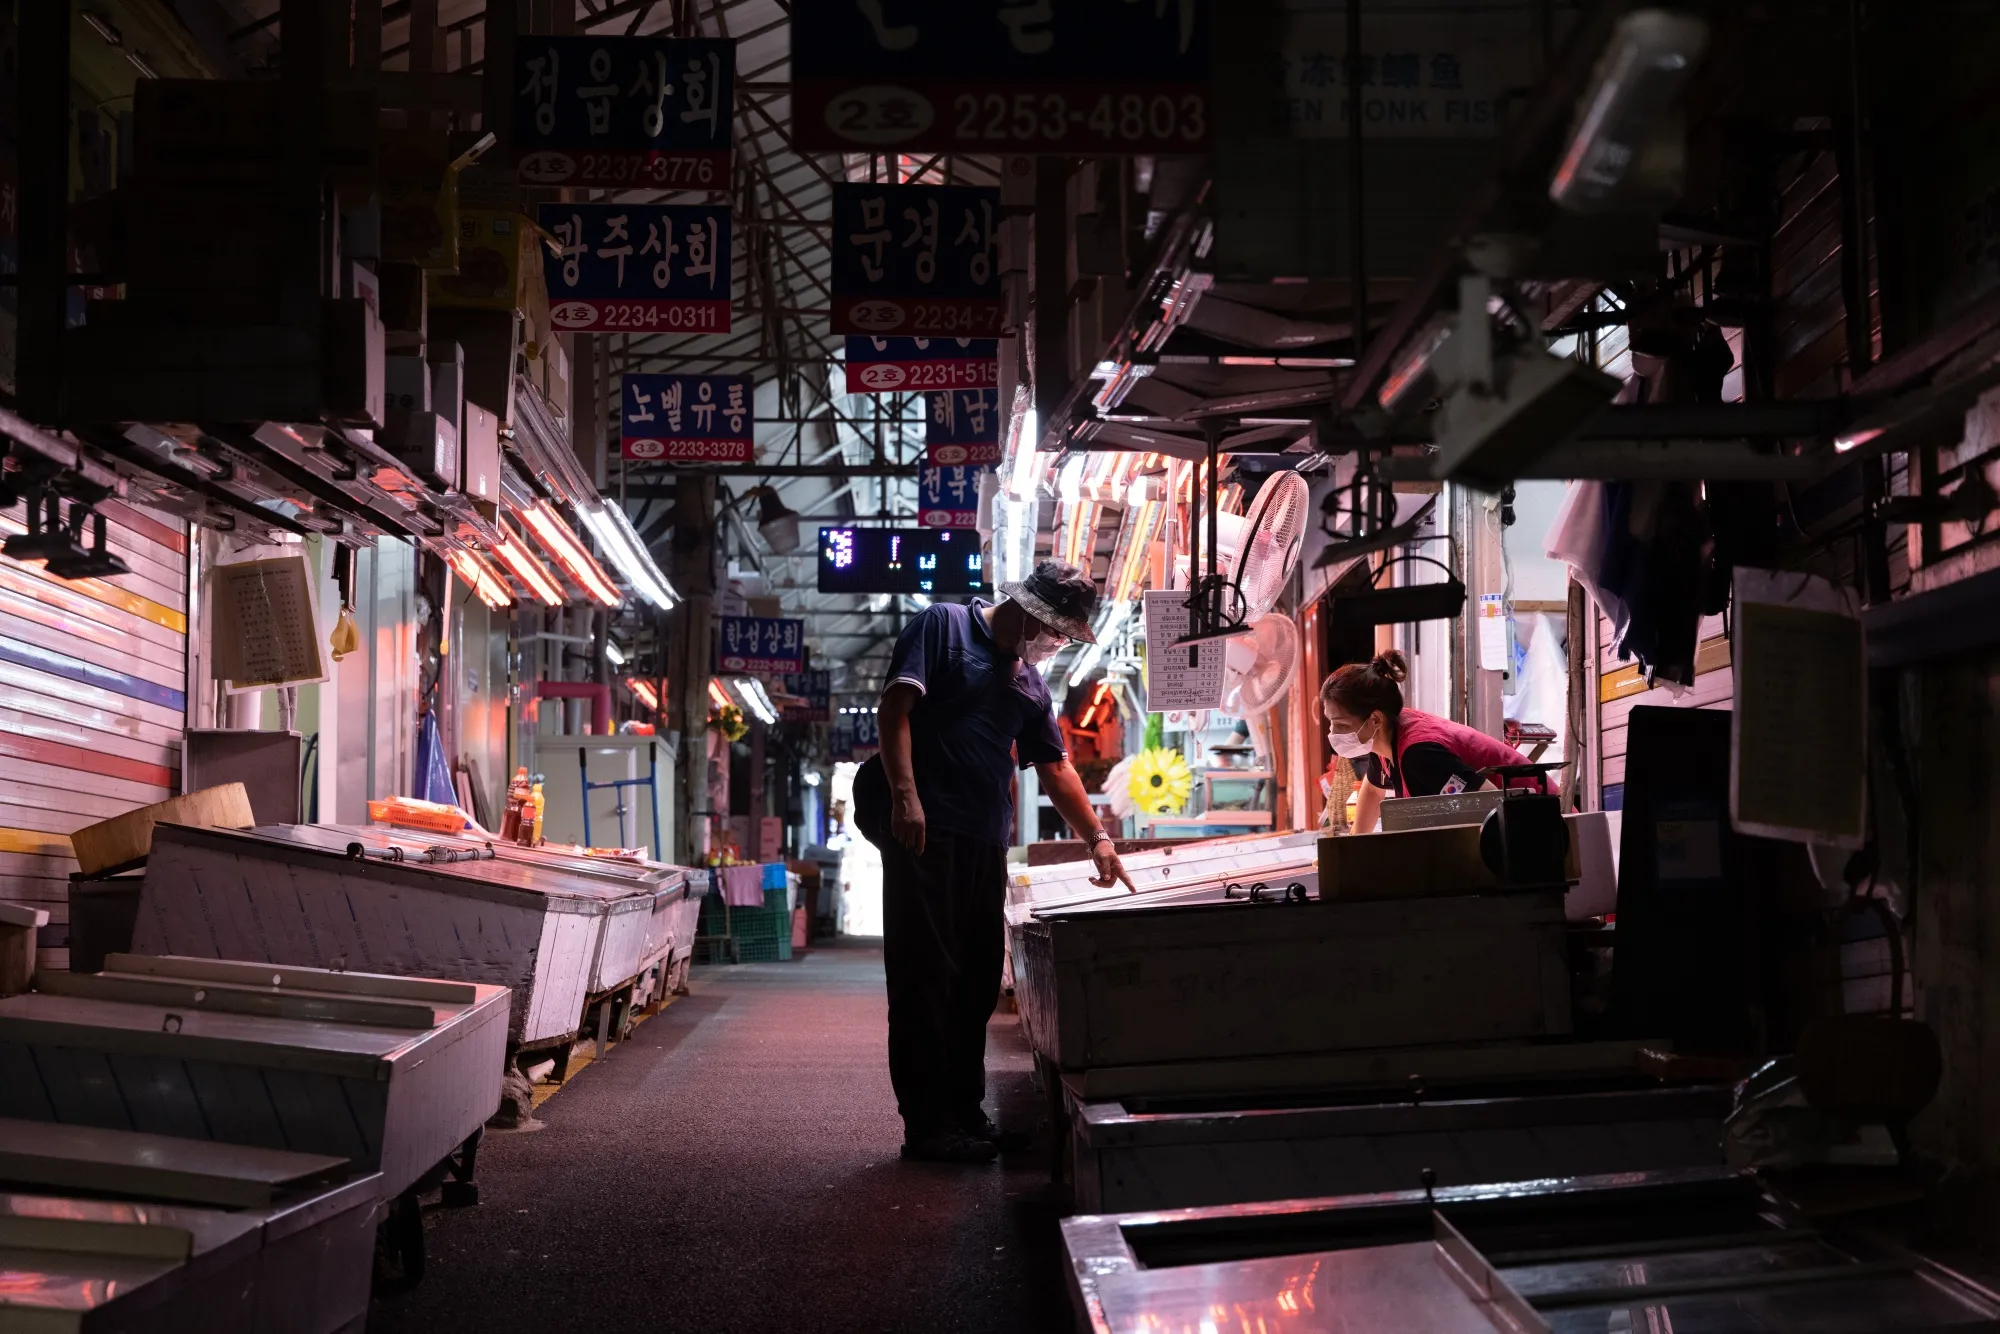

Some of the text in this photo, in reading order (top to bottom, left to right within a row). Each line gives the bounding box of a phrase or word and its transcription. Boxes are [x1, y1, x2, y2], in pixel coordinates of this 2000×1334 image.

[519, 46, 720, 141] 정읍상회
[838, 91, 1206, 141] 2호 2253-4803
[525, 154, 714, 184] 4호 2237-3776
[550, 213, 719, 291] 광주상회
[554, 304, 717, 327] 4호 2234-0311
[856, 304, 998, 331] 2호 2234-7
[866, 368, 900, 383] 2호
[628, 381, 747, 433] 노벨유통
[933, 390, 998, 436] 해남
[635, 441, 745, 457] 3호 2233-3378
[726, 620, 799, 656] 한성상회
